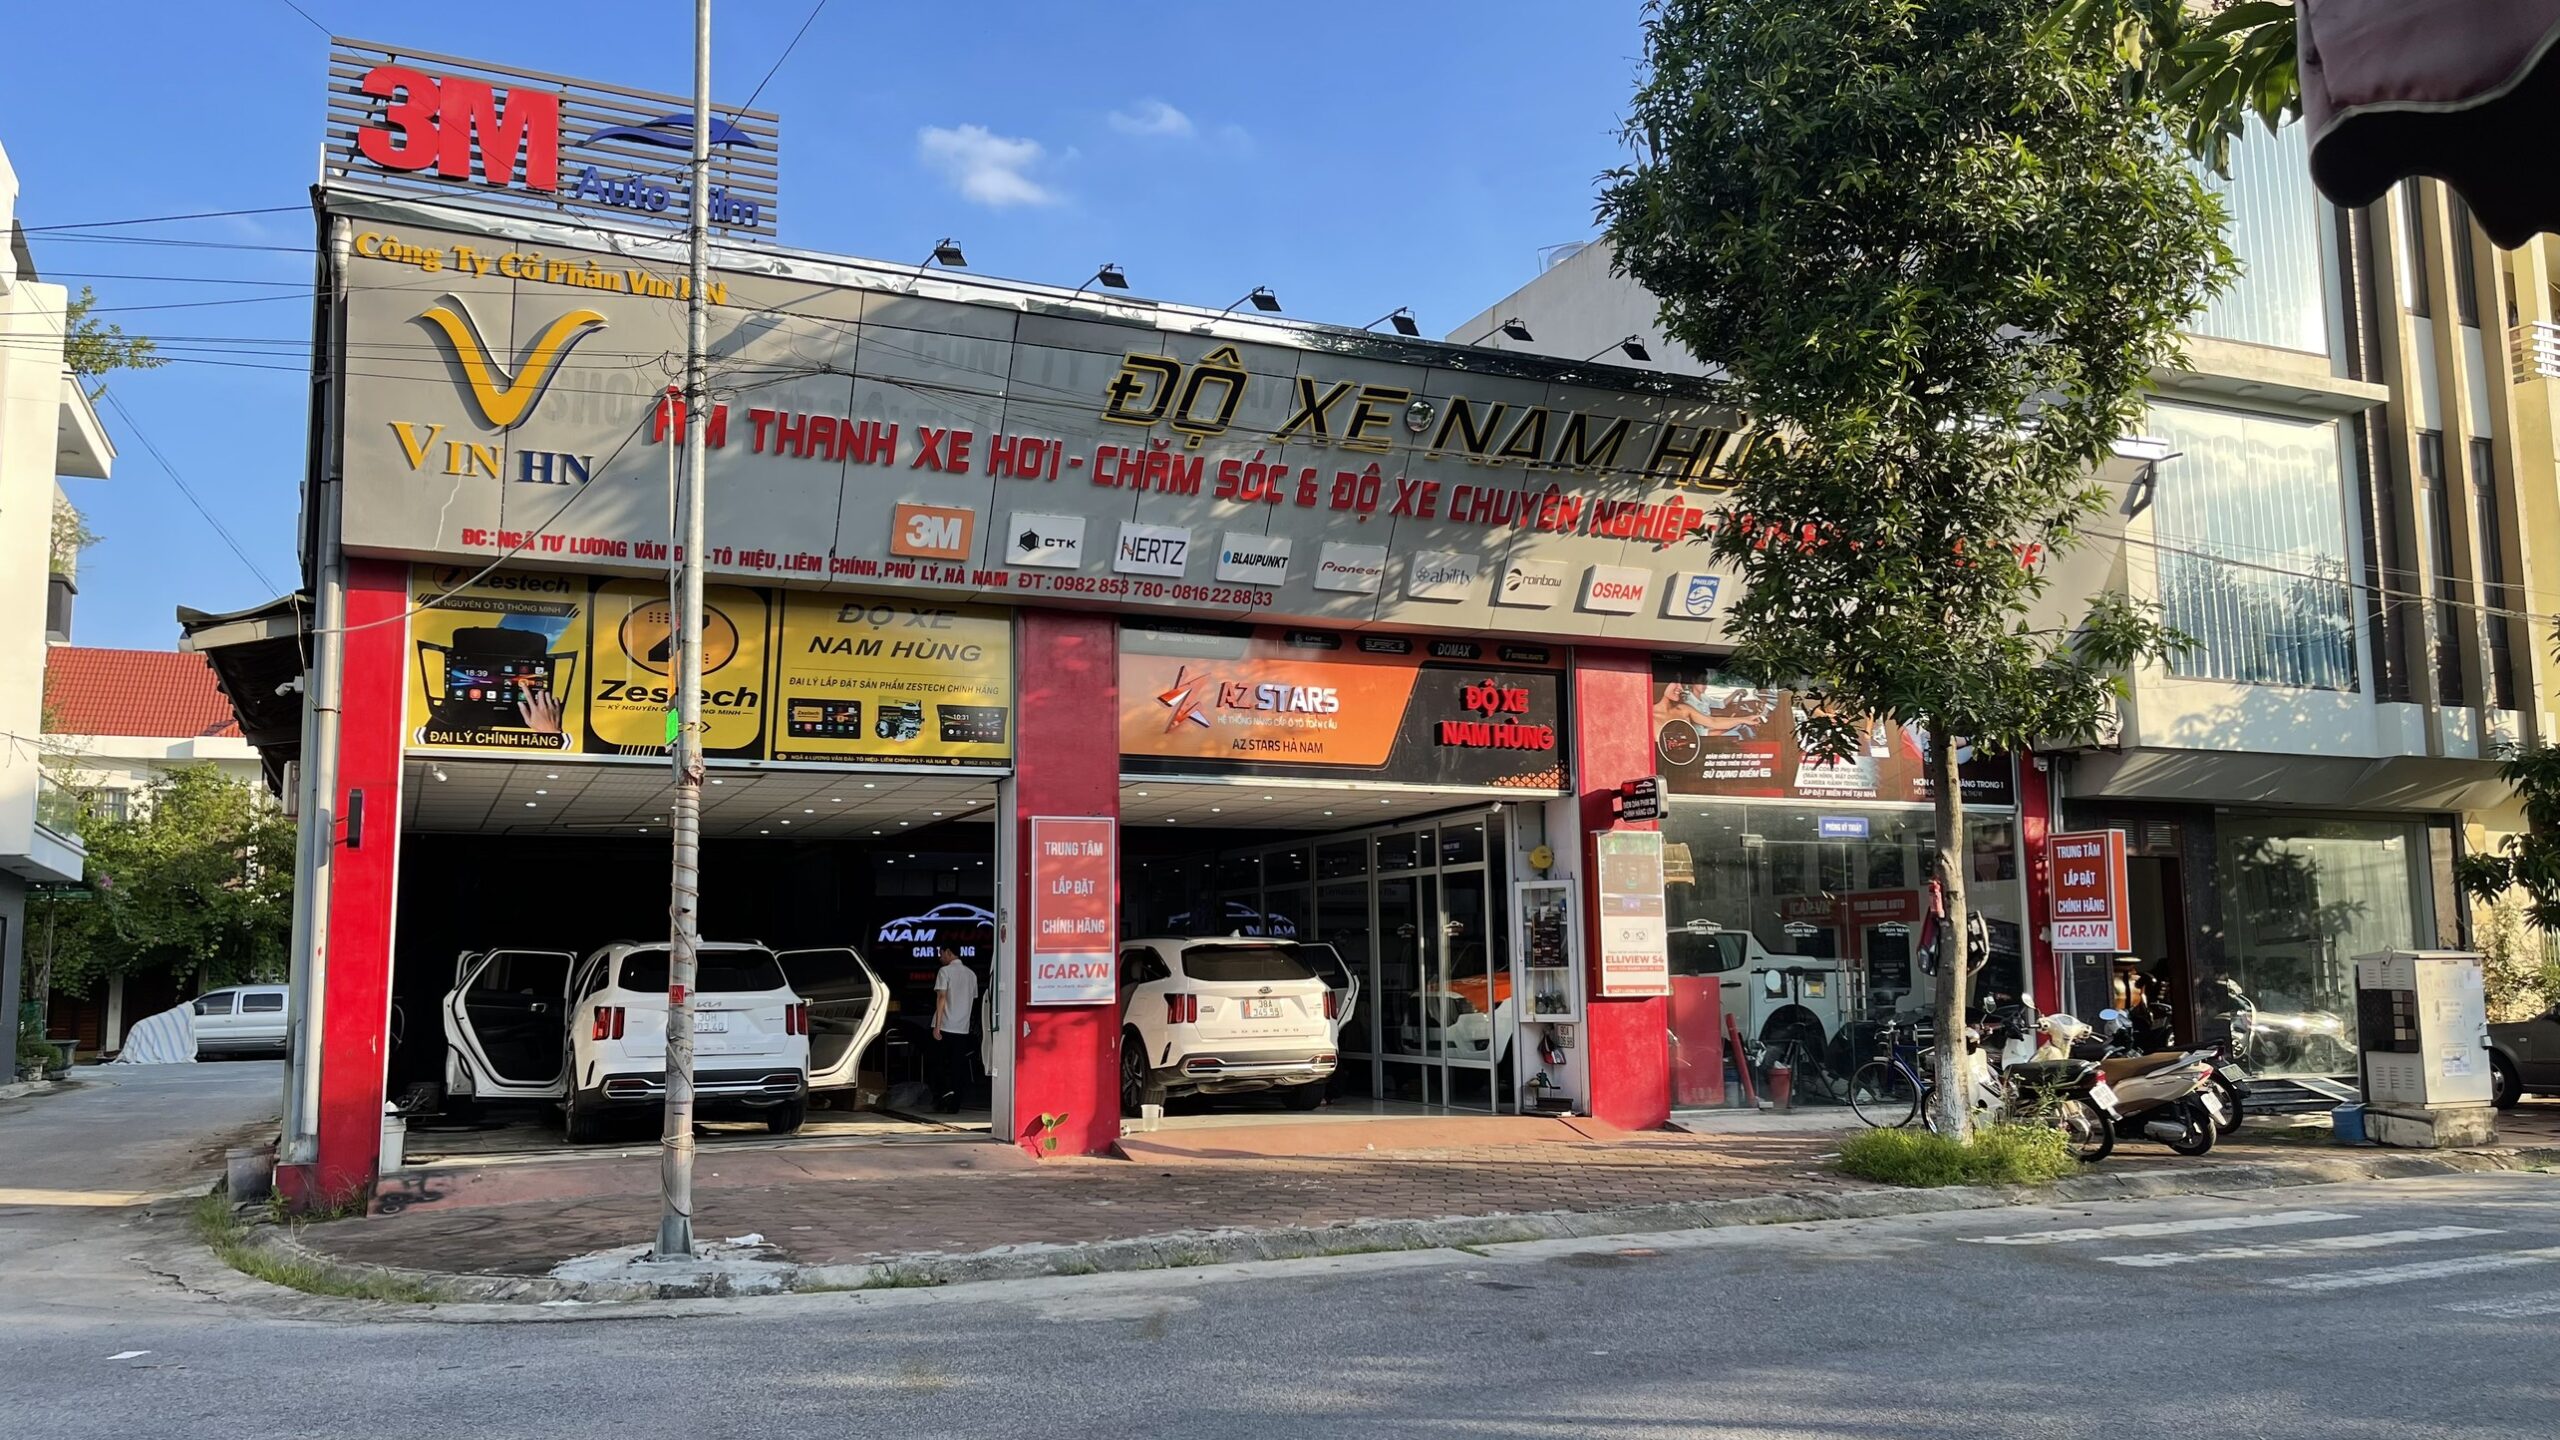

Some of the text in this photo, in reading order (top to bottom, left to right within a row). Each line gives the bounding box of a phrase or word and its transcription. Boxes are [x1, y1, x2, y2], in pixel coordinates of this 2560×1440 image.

[358, 65, 558, 193] 3M
[575, 165, 759, 227] Auto ilm
[353, 230, 443, 273] Công
[453, 244, 489, 278] Ty
[498, 249, 545, 282] Cổ
[1100, 343, 1249, 449] ĐỘ
[1268, 375, 1412, 453] XE
[1423, 395, 1634, 475] NAM
[515, 449, 596, 486] HN
[747, 407, 899, 467] THANH
[911, 426, 974, 473] XE
[986, 433, 1063, 481] HƠI
[1091, 438, 1204, 497] CHĂM
[1213, 449, 1289, 503] SÓC
[1296, 467, 1319, 507] &
[1329, 462, 1382, 522] ĐỘ
[1388, 477, 1441, 520] XE
[1448, 482, 1582, 533] CHUYÊN
[1588, 494, 1705, 549] NGHIỆP
[905, 514, 963, 550] 3M
[1043, 537, 1077, 550] CTK
[1120, 535, 1187, 566] HERTZ
[1231, 551, 1289, 570] BLAUPUNKT
[1321, 560, 1382, 577] Pioneer
[541, 534, 565, 552] TƯ
[570, 537, 628, 557] LƯƠNG
[634, 540, 667, 561] VĂN
[944, 565, 965, 584] HÀ
[972, 569, 1008, 587] NAM
[1099, 578, 1130, 595] 853
[1232, 589, 1274, 607] 8833
[1429, 563, 1475, 587] ability
[1522, 573, 1562, 587] rainbow
[472, 572, 571, 594] Zestech
[1592, 581, 1644, 600] OSRAM
[1692, 578, 1719, 586] PHILIPS
[837, 602, 958, 630] ĐỘ XE
[808, 635, 982, 662] NAM HÙNG
[1437, 642, 1472, 657] DOMAX
[465, 668, 488, 678] 18:39
[597, 679, 759, 708] Zesech
[906, 682, 945, 693] ZESTECH
[1216, 681, 1339, 714] AZ STARS
[1466, 678, 1529, 717] ĐỘ XE
[429, 729, 559, 747] ĐẠI LÝ CHÍNH HÃNG
[1442, 716, 1555, 750] NAM HÙNG
[1232, 737, 1323, 754] AZ STARS HÀ NAM
[1977, 780, 2000, 789] TRONG
[1044, 839, 1103, 856] TRUNG TÂM
[2056, 842, 2101, 859] TRUNG TÂM
[1052, 876, 1095, 897] LẮP ĐẶT
[2064, 868, 2096, 888] LẮP ĐẶT
[2057, 896, 2105, 913] CHÍNH HÃNG
[1042, 917, 1105, 934] CHÍNH HÃNG
[2058, 924, 2109, 938] ICAR.VN
[878, 929, 937, 942] NAM
[913, 946, 935, 958] CAR
[1605, 955, 1649, 964] ELLIVIEW
[1038, 963, 1109, 980] ICAR.VN
